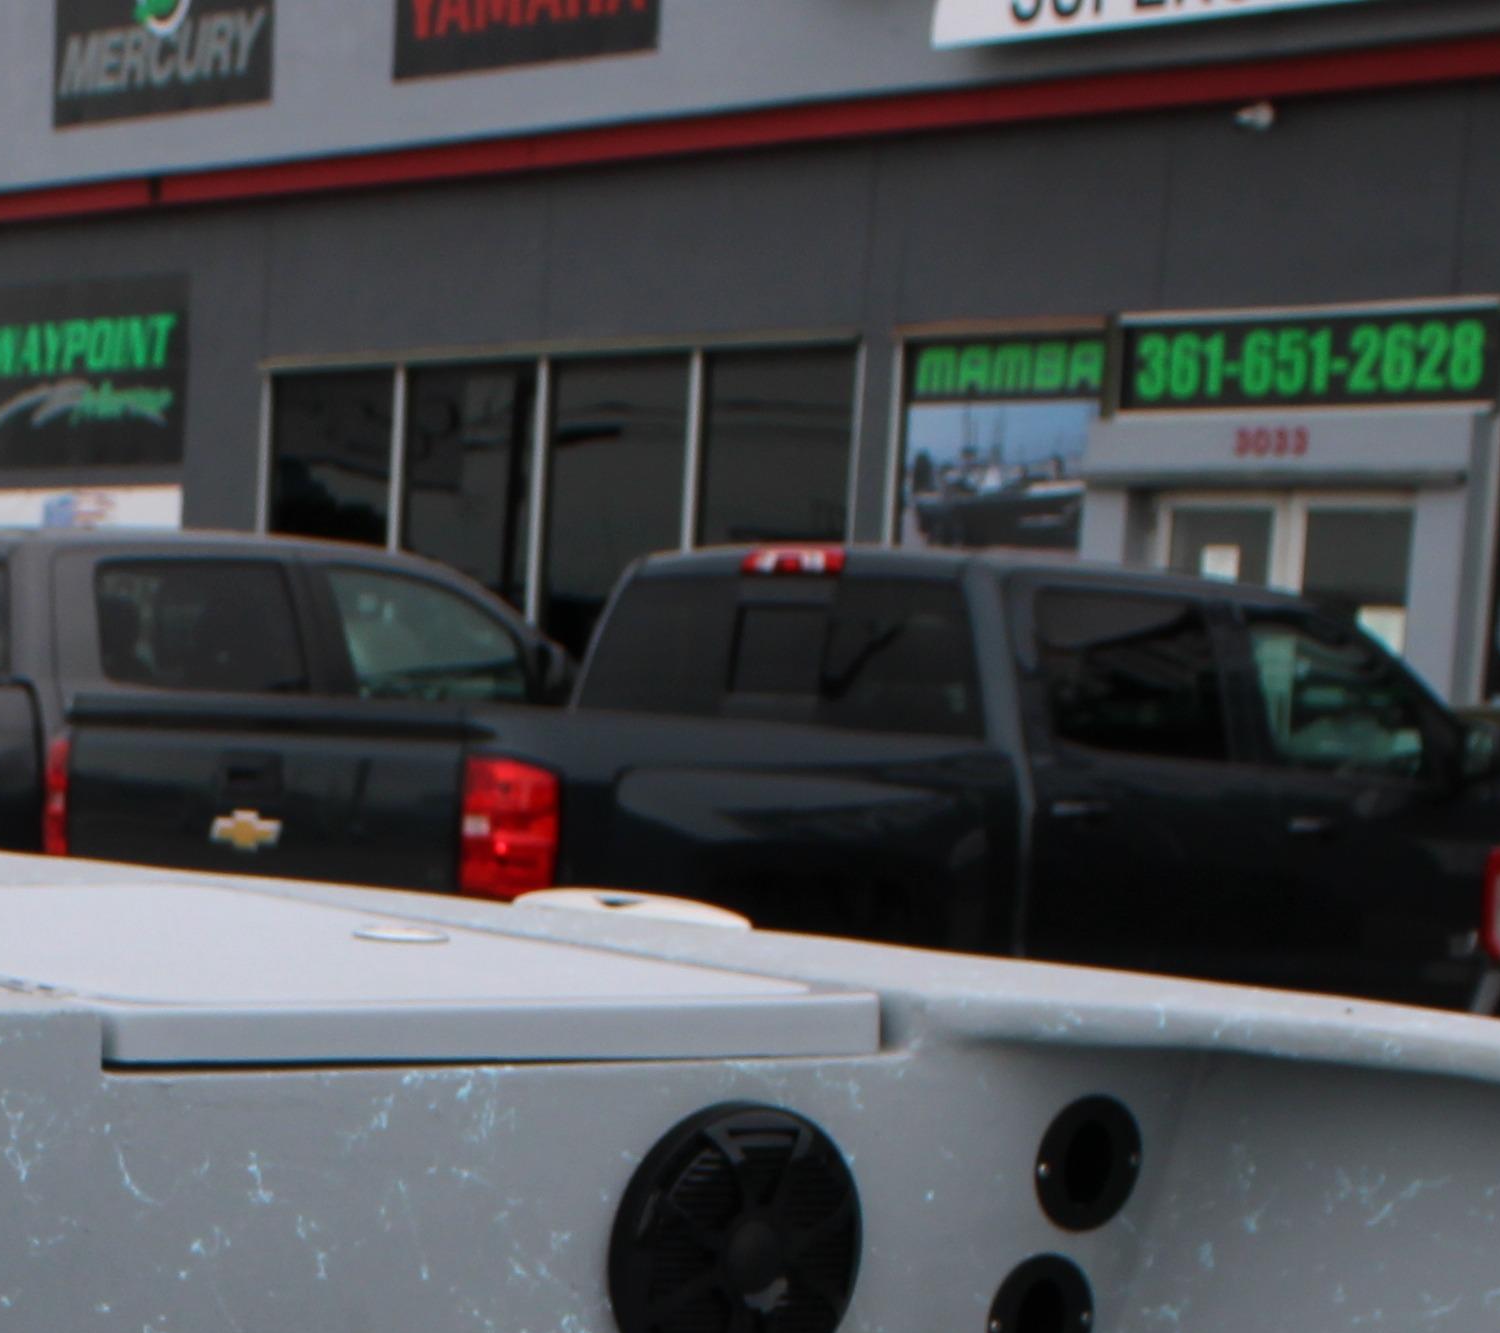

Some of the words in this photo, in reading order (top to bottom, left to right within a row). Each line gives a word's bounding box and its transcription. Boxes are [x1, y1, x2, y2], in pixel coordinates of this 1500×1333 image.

[59, 6, 267, 98] MERCURY
[411, 0, 649, 40] YAMA
[914, 340, 1106, 394] MAMBA
[1134, 319, 1486, 399] 361-651-2628
